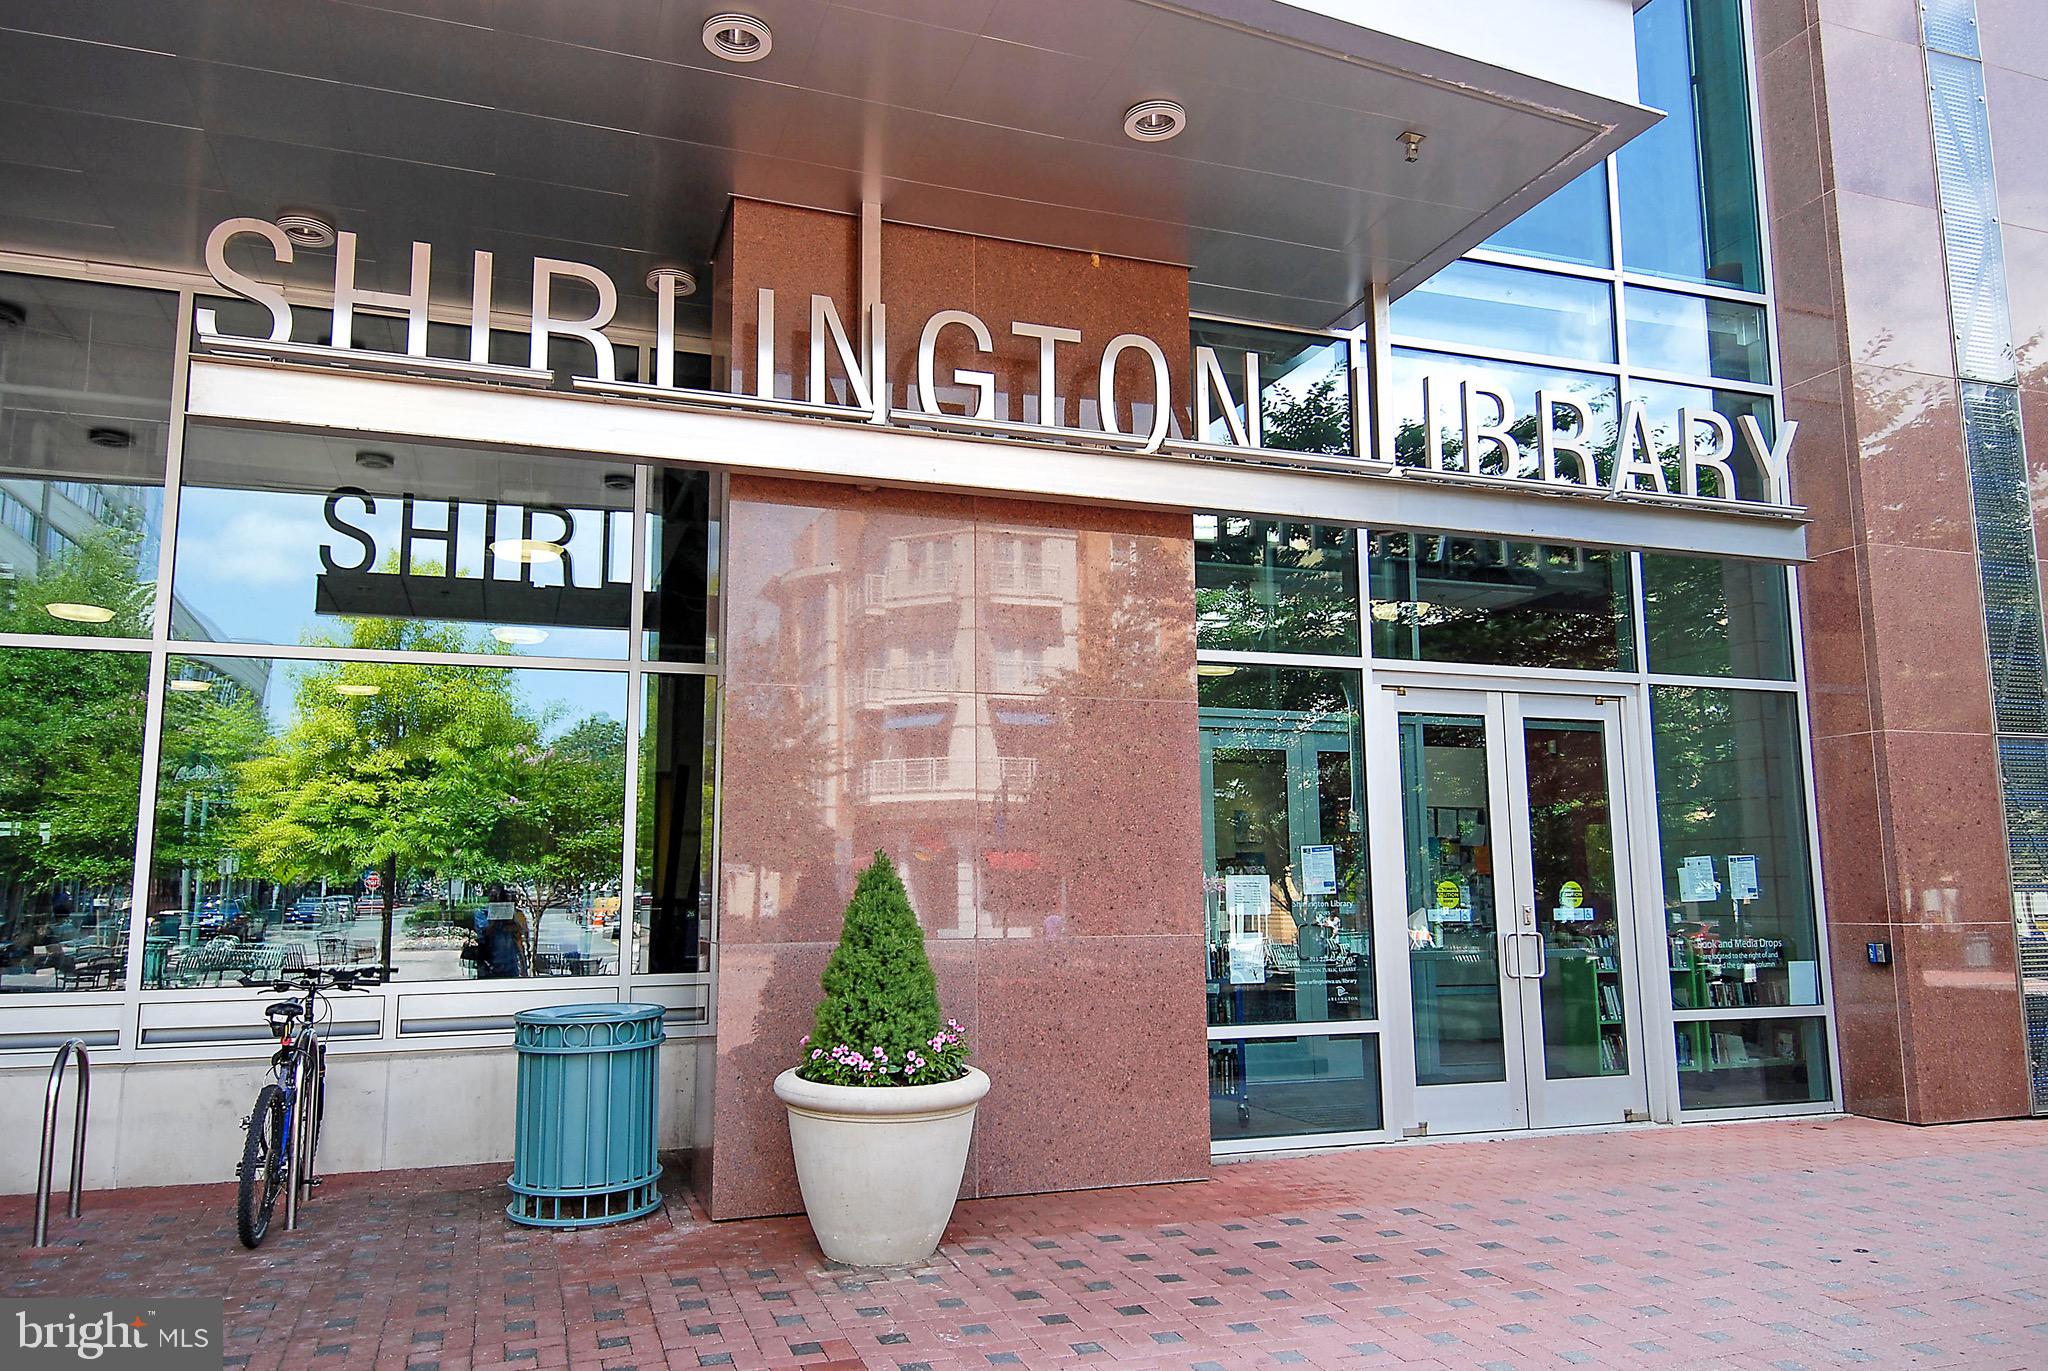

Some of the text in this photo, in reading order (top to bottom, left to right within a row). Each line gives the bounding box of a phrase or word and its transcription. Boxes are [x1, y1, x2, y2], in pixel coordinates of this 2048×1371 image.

[1351, 366, 1798, 507] LIBRARY
[1292, 899, 1353, 910] Shington Library
[1718, 938, 1733, 948] and
[1734, 938, 1758, 948] Media
[1759, 938, 1783, 950] Drops
[1748, 952, 1761, 960] right
[1756, 960, 1776, 968] column
